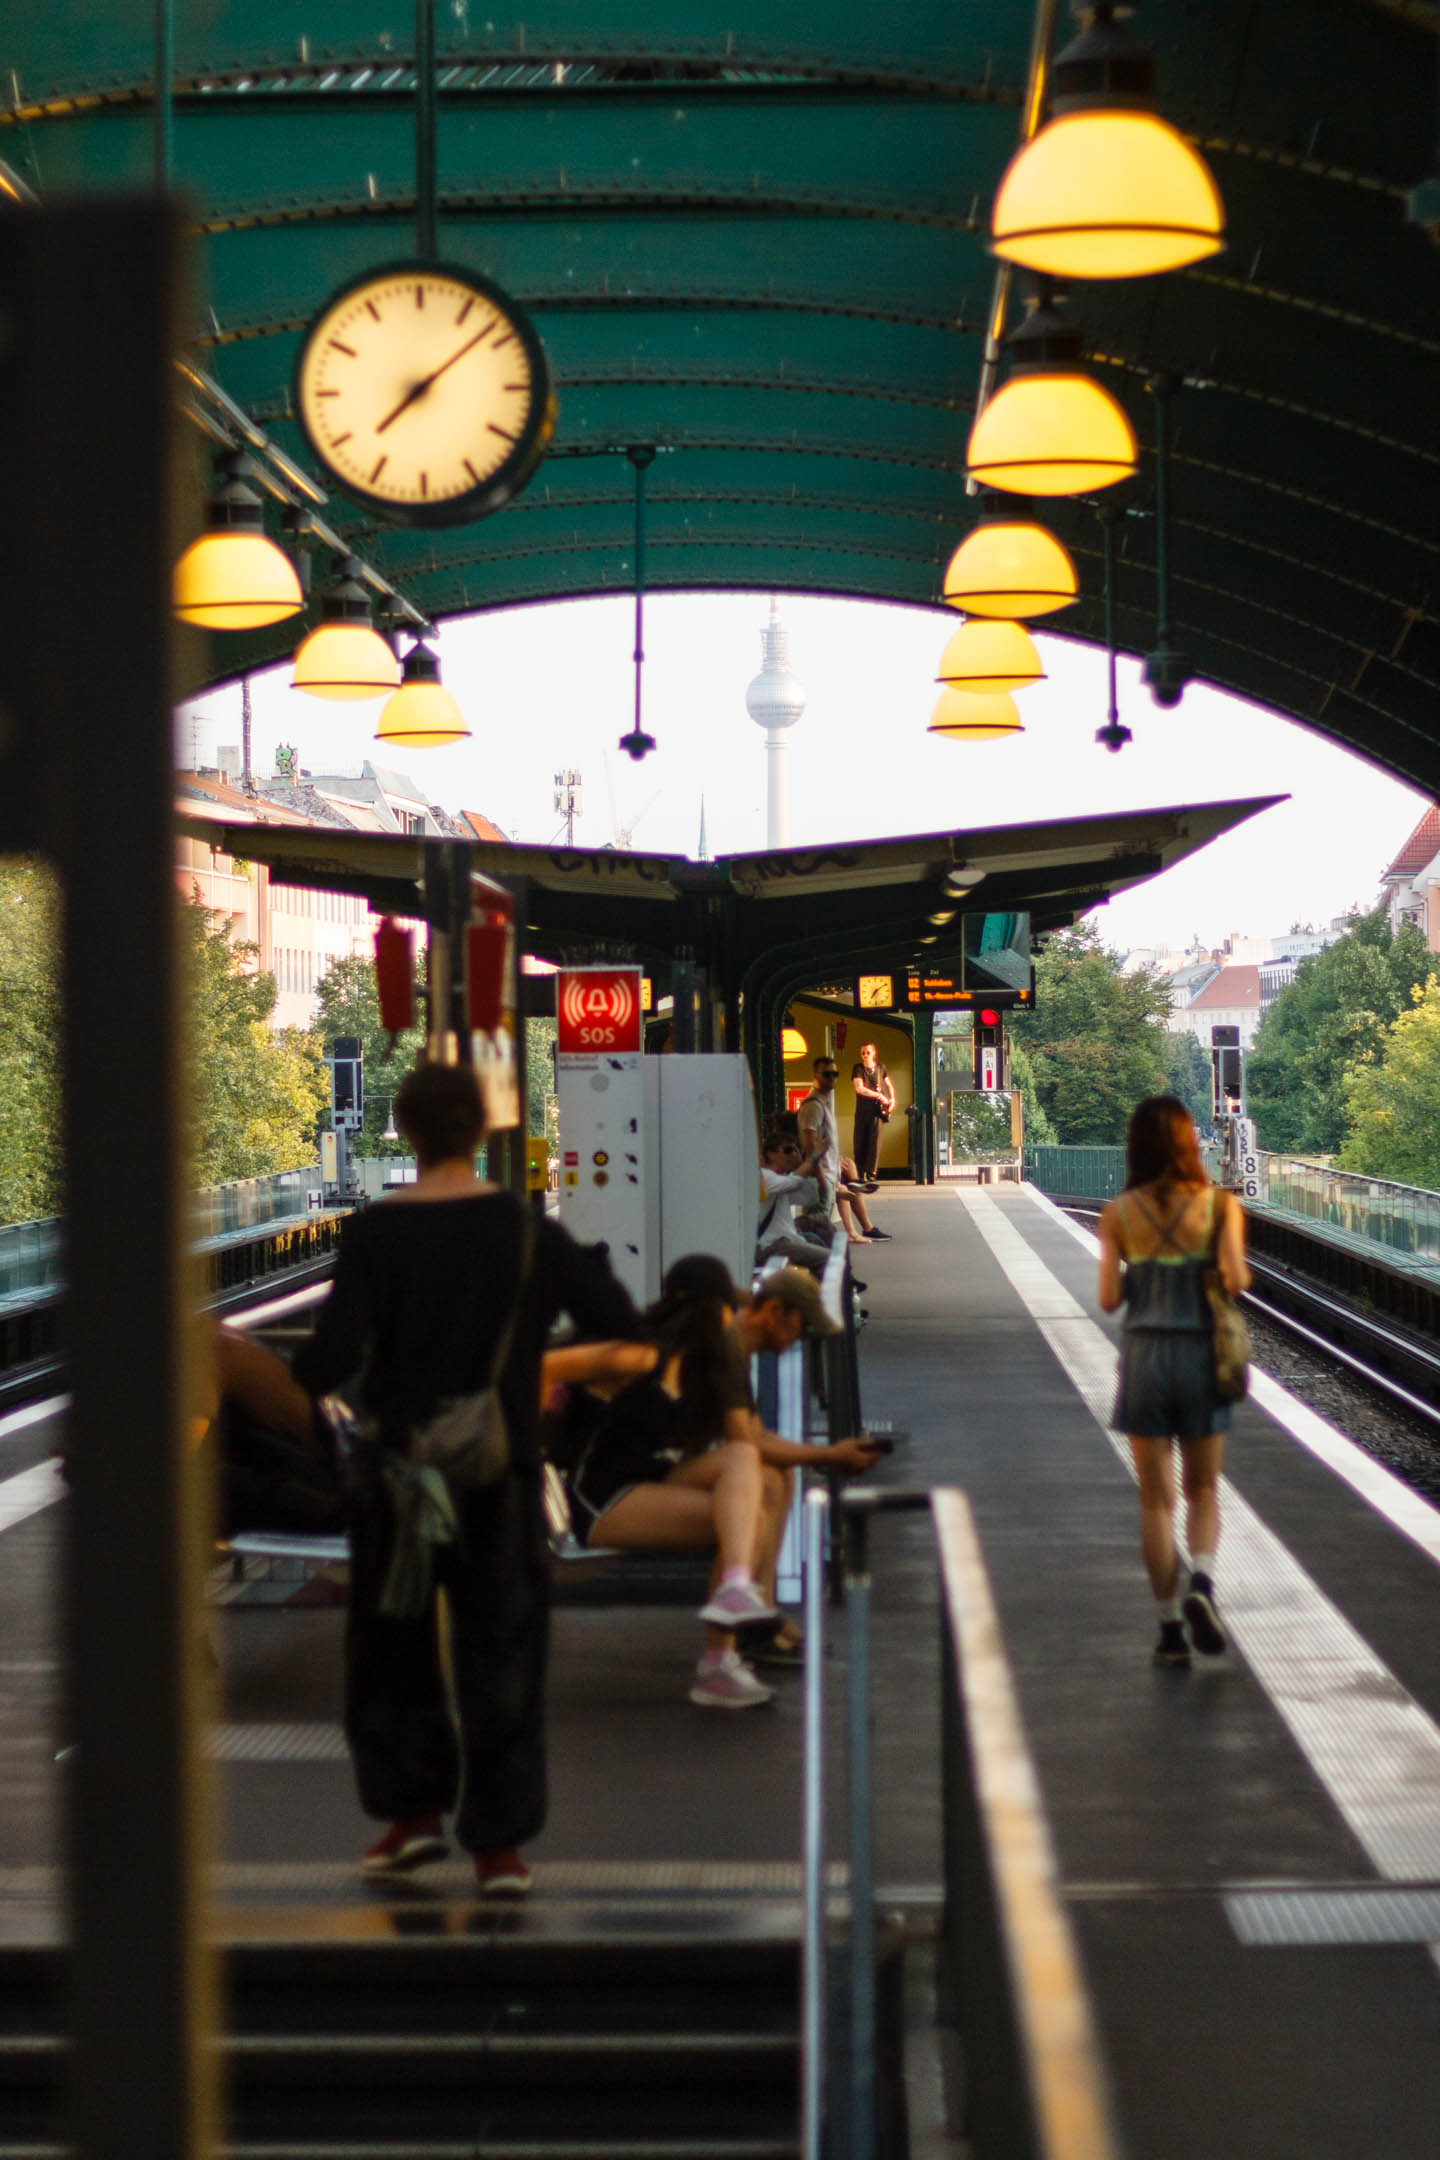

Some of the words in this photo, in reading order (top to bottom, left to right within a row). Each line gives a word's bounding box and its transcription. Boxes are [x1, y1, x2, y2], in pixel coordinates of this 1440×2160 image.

[580, 1027, 615, 1044] SOS
[1245, 1157, 1257, 1174] 8
[1246, 1180, 1257, 1197] 6
[309, 1192, 321, 1209] H
